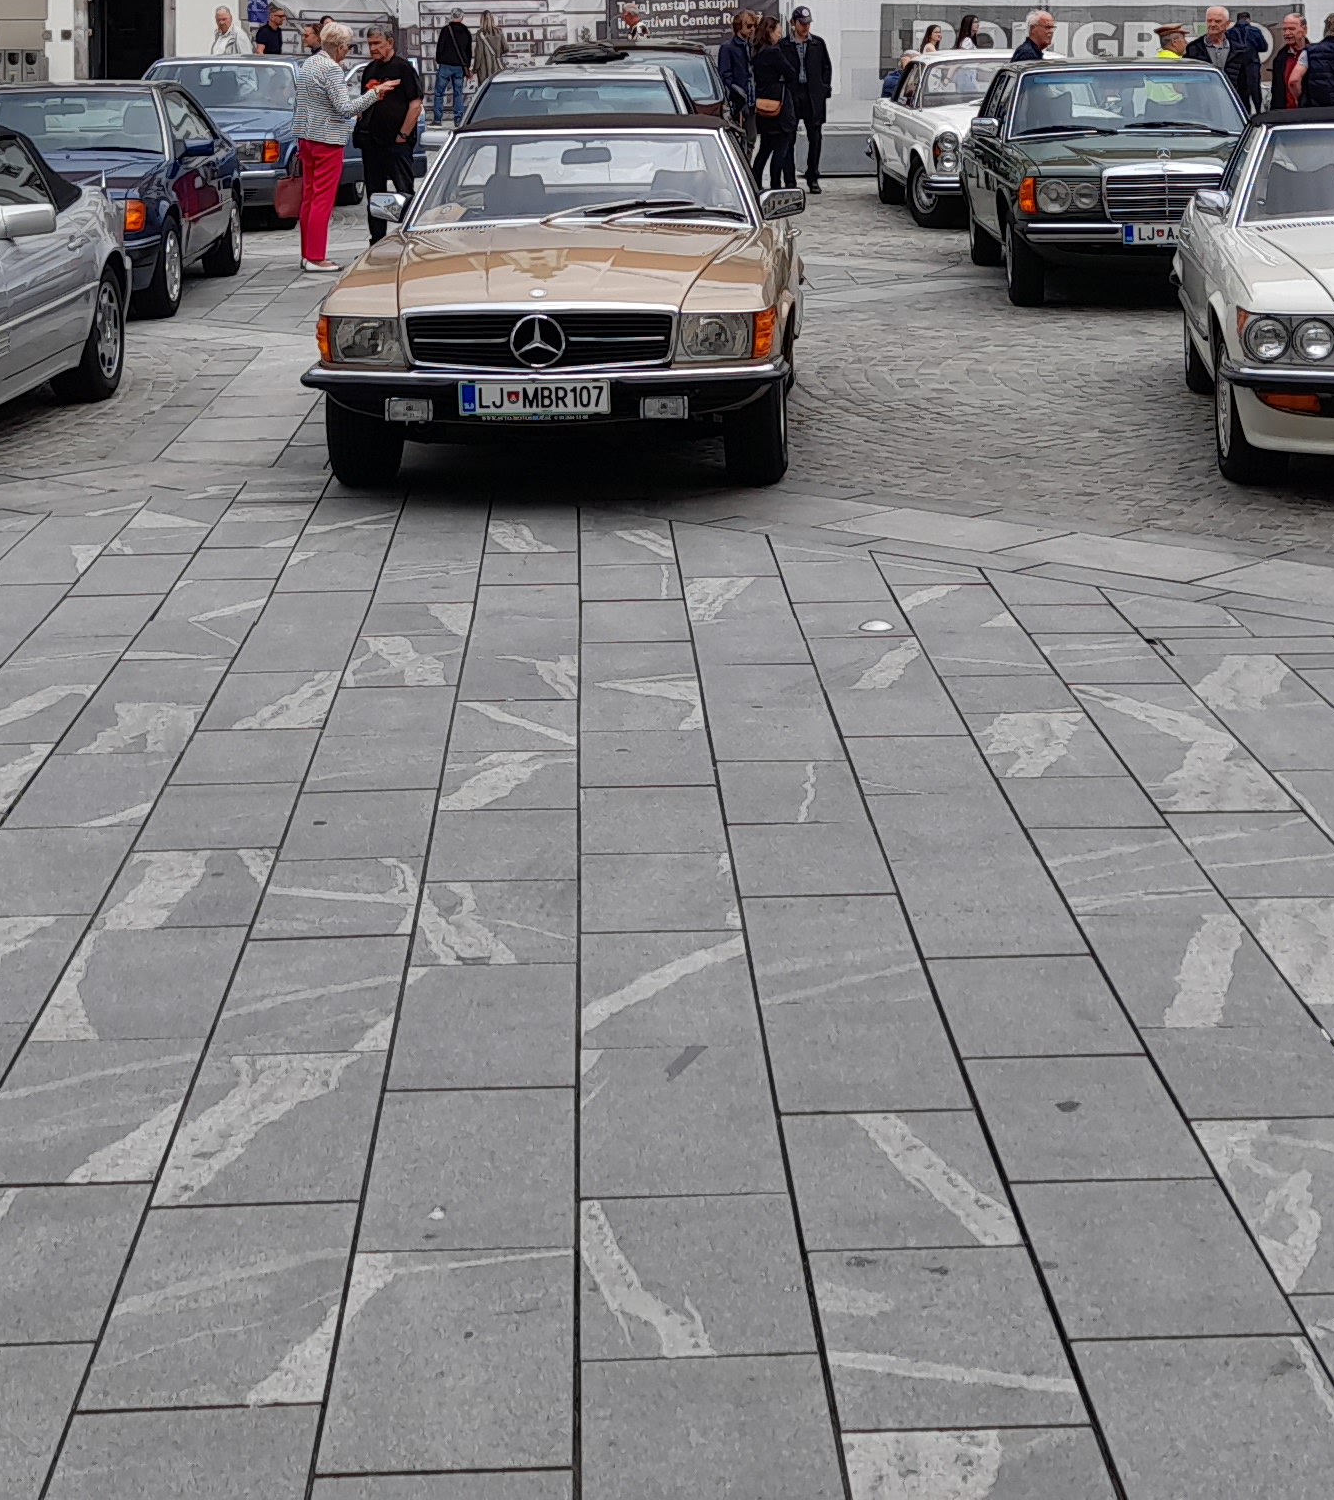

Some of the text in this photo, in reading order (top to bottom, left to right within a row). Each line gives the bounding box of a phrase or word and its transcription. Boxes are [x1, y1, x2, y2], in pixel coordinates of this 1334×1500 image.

[617, 0, 650, 14] Taj
[618, 14, 678, 30] inativni
[679, 13, 720, 28] Center
[1138, 227, 1155, 240] LJ
[478, 386, 604, 409] LJ MBR107
